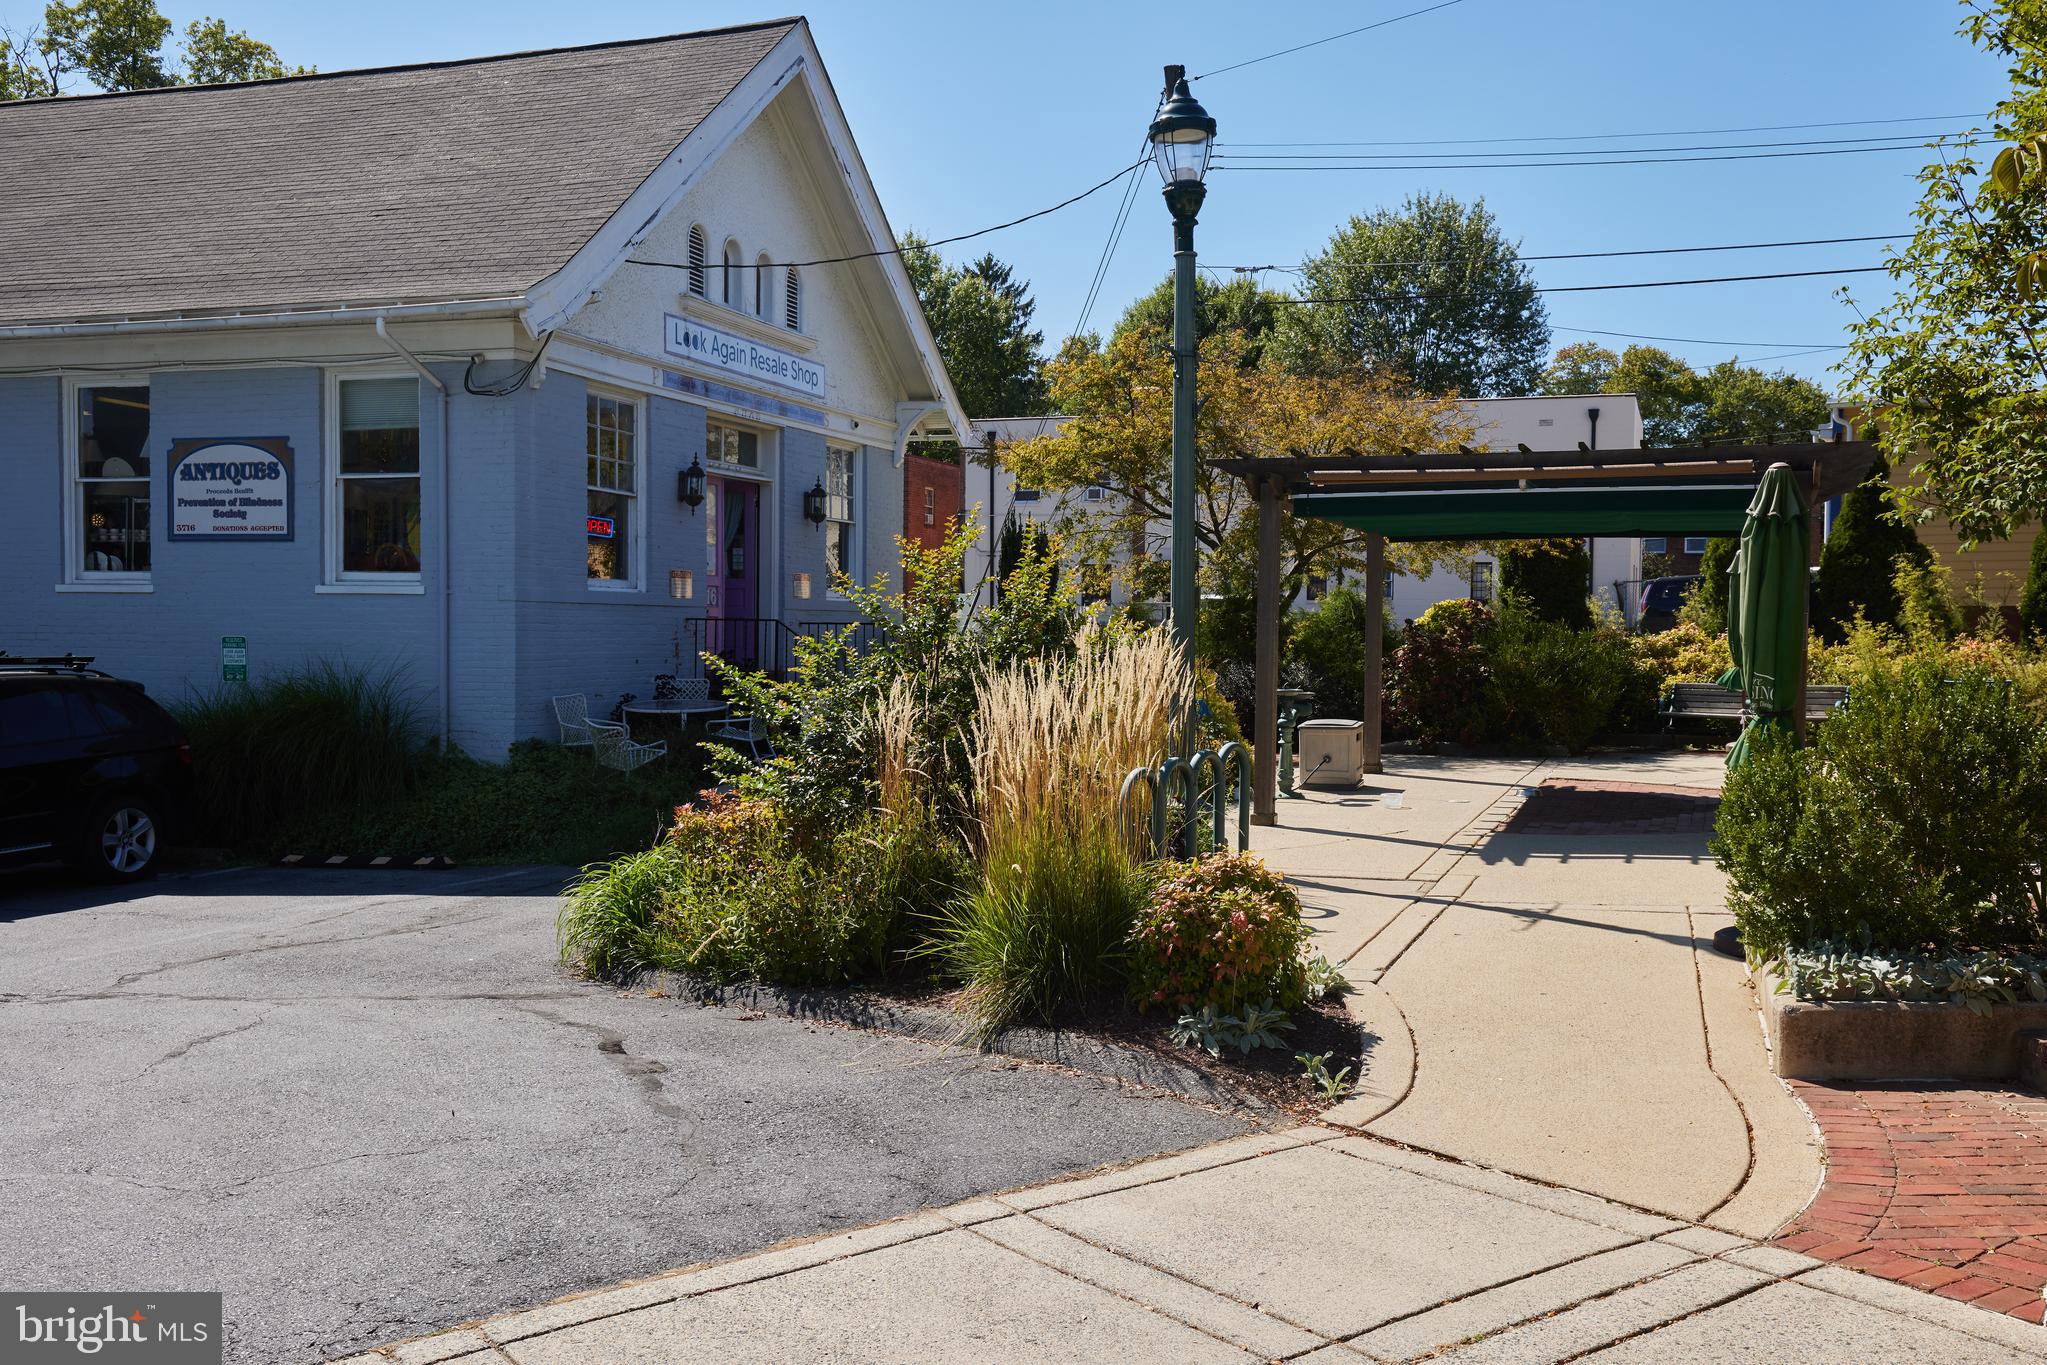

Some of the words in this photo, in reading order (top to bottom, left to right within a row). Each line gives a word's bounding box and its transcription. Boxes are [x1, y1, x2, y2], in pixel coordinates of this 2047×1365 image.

[674, 322, 708, 354] Look
[710, 335, 747, 365] Again
[750, 346, 788, 378] Resale
[791, 359, 819, 390] Shop
[180, 461, 281, 485] ANTIQUES
[177, 497, 226, 507] Prevention
[228, 497, 238, 507] of
[238, 497, 283, 507] Blindness
[212, 508, 248, 520] Society
[176, 524, 196, 532] 3716
